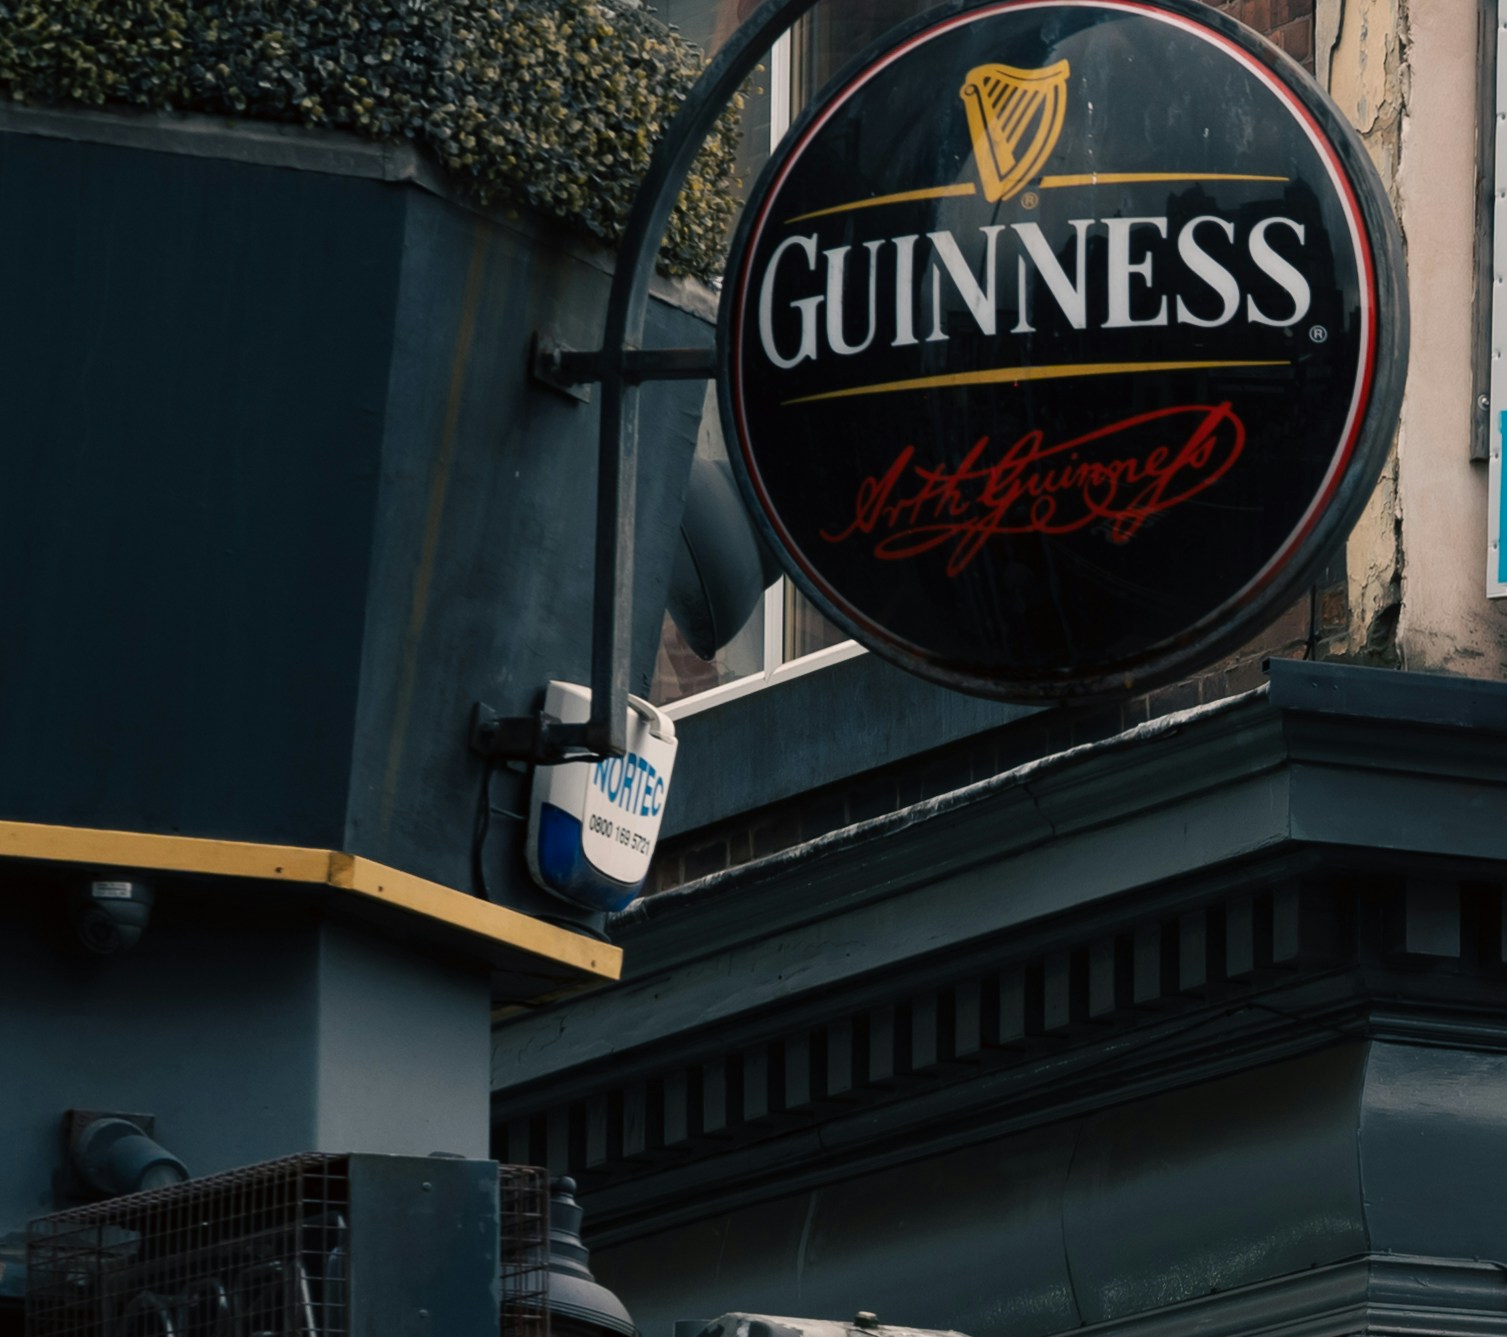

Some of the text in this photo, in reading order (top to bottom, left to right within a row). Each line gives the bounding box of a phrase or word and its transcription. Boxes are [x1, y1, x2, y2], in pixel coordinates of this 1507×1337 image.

[757, 214, 1312, 370] GUINNESS
[593, 752, 665, 817] NORTEC
[588, 814, 613, 839] 0800
[615, 824, 631, 847] 169
